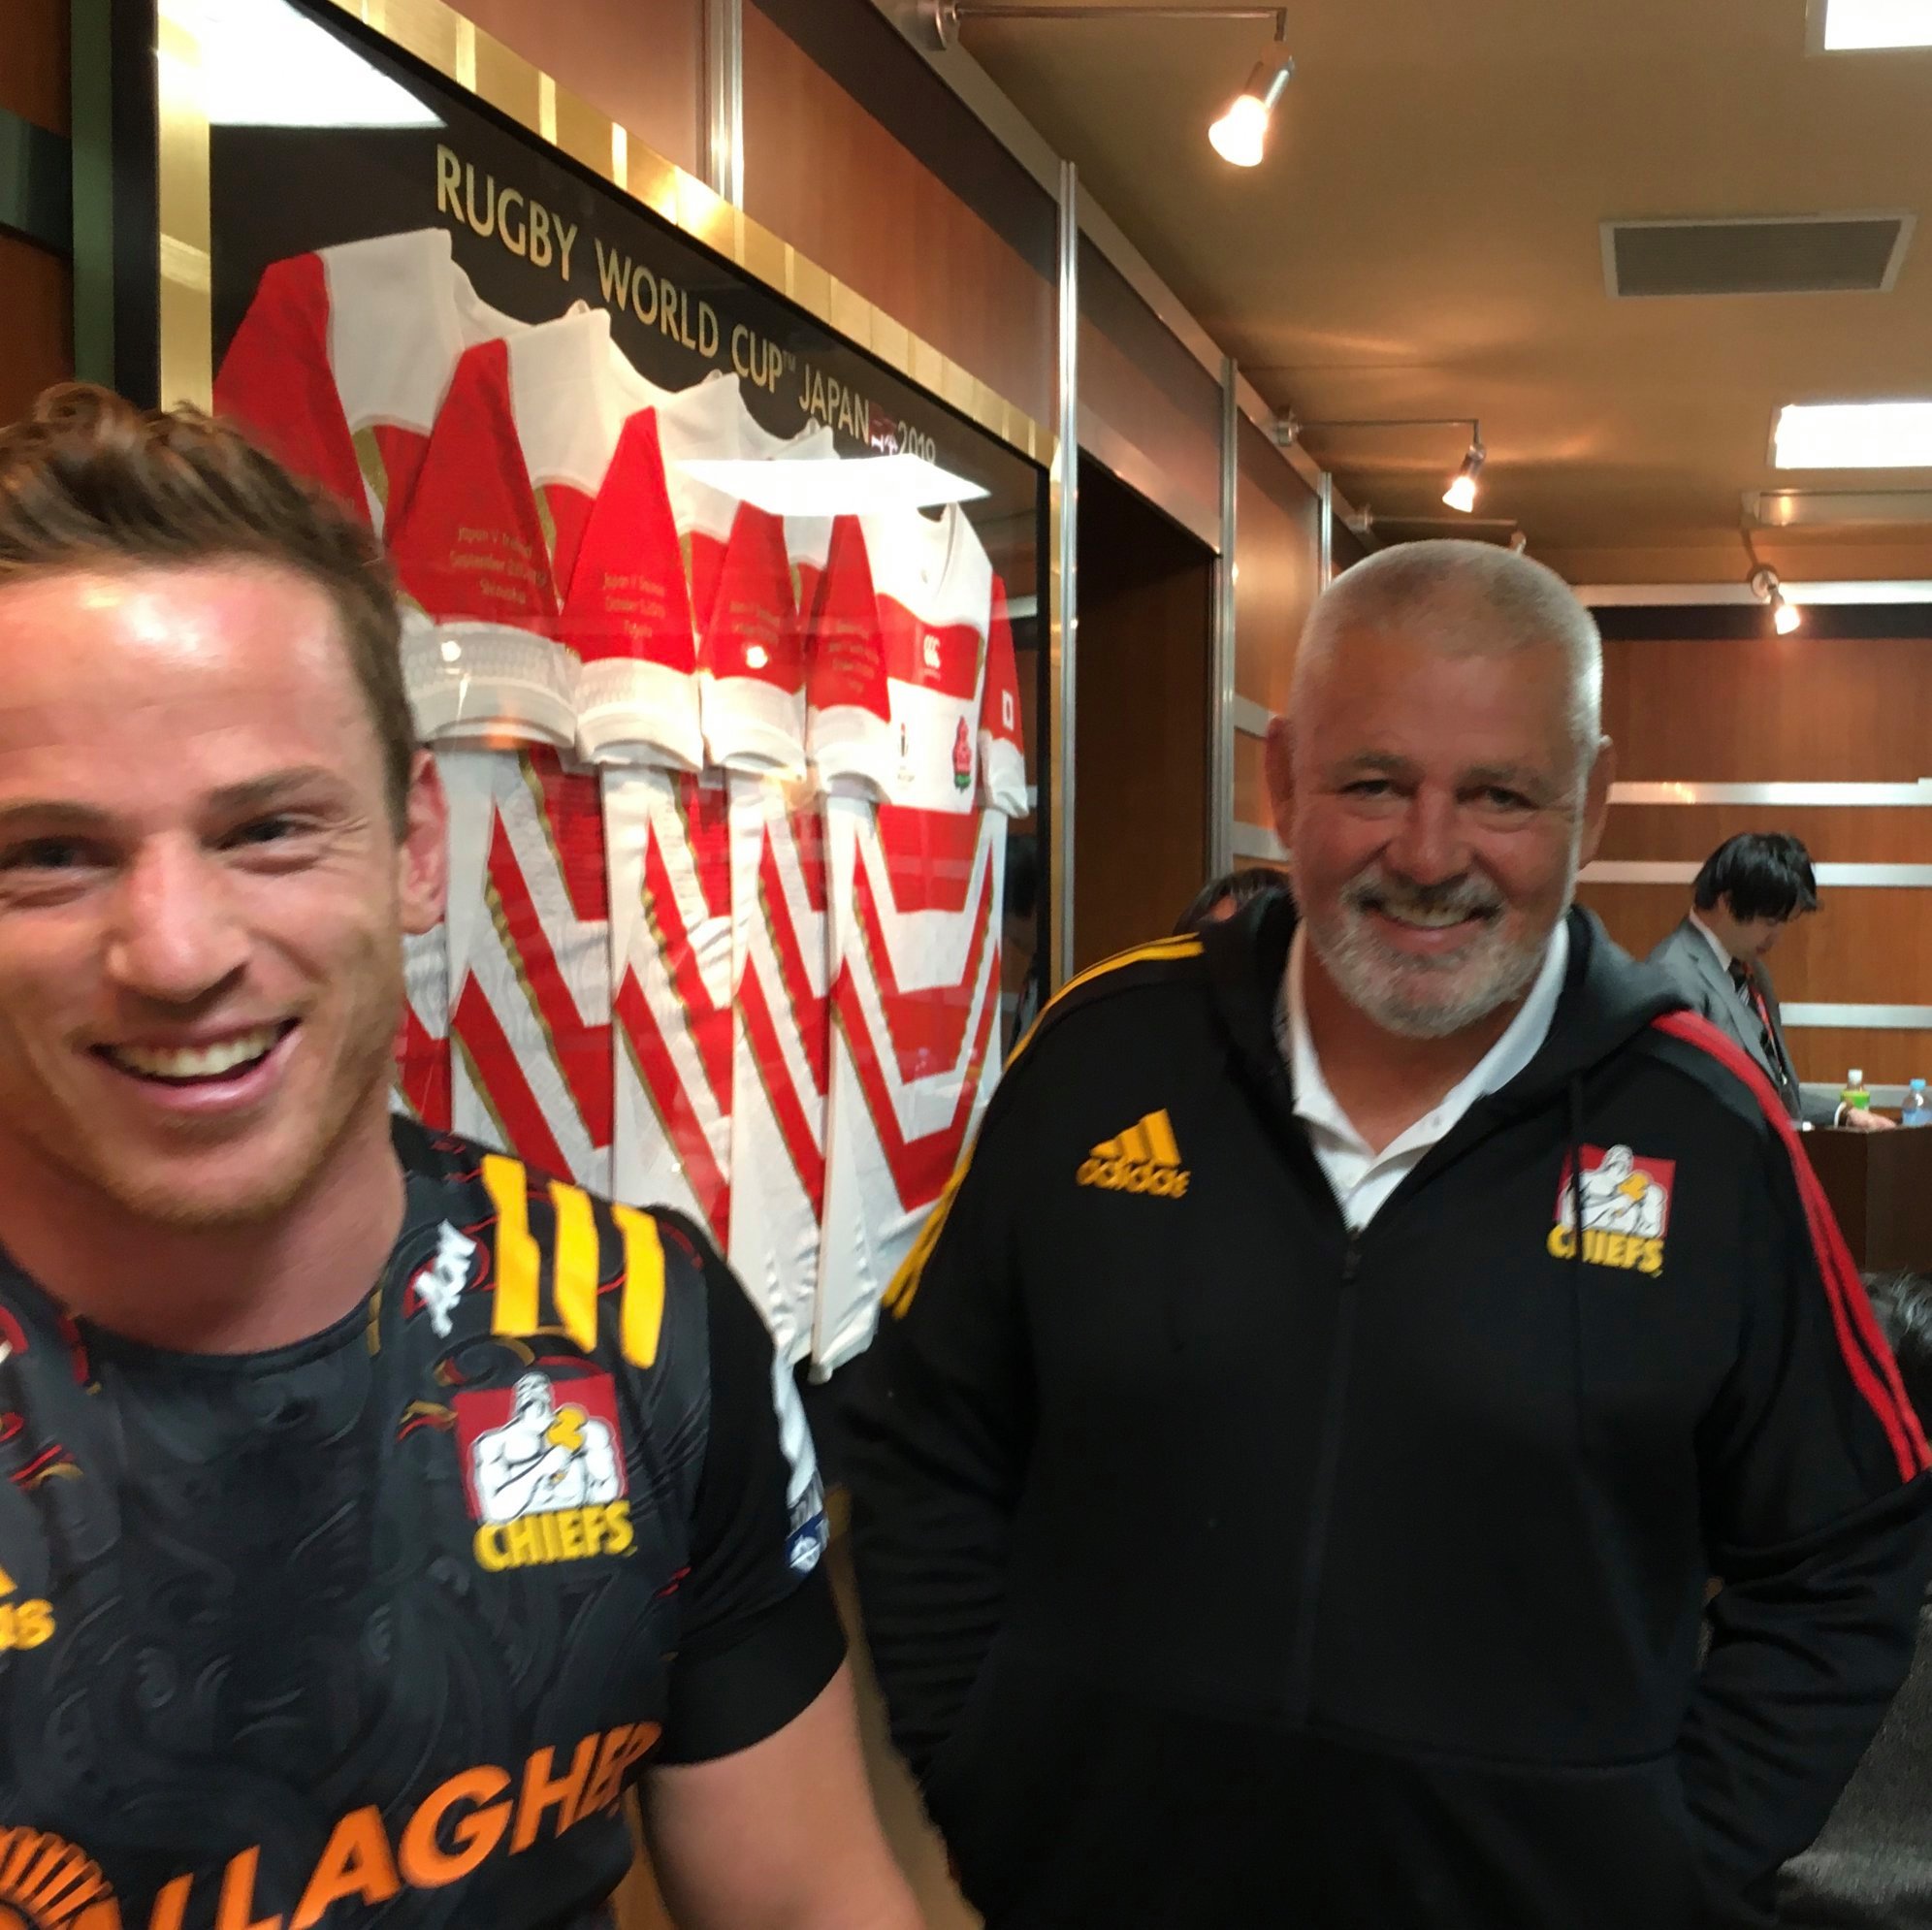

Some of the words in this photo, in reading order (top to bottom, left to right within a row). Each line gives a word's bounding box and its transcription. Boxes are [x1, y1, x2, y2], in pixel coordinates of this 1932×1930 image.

[436, 145, 578, 281] RUGBY
[595, 238, 720, 358] WORLD
[799, 363, 869, 446] JAPAN
[472, 1499, 635, 1573] CHIEFS
